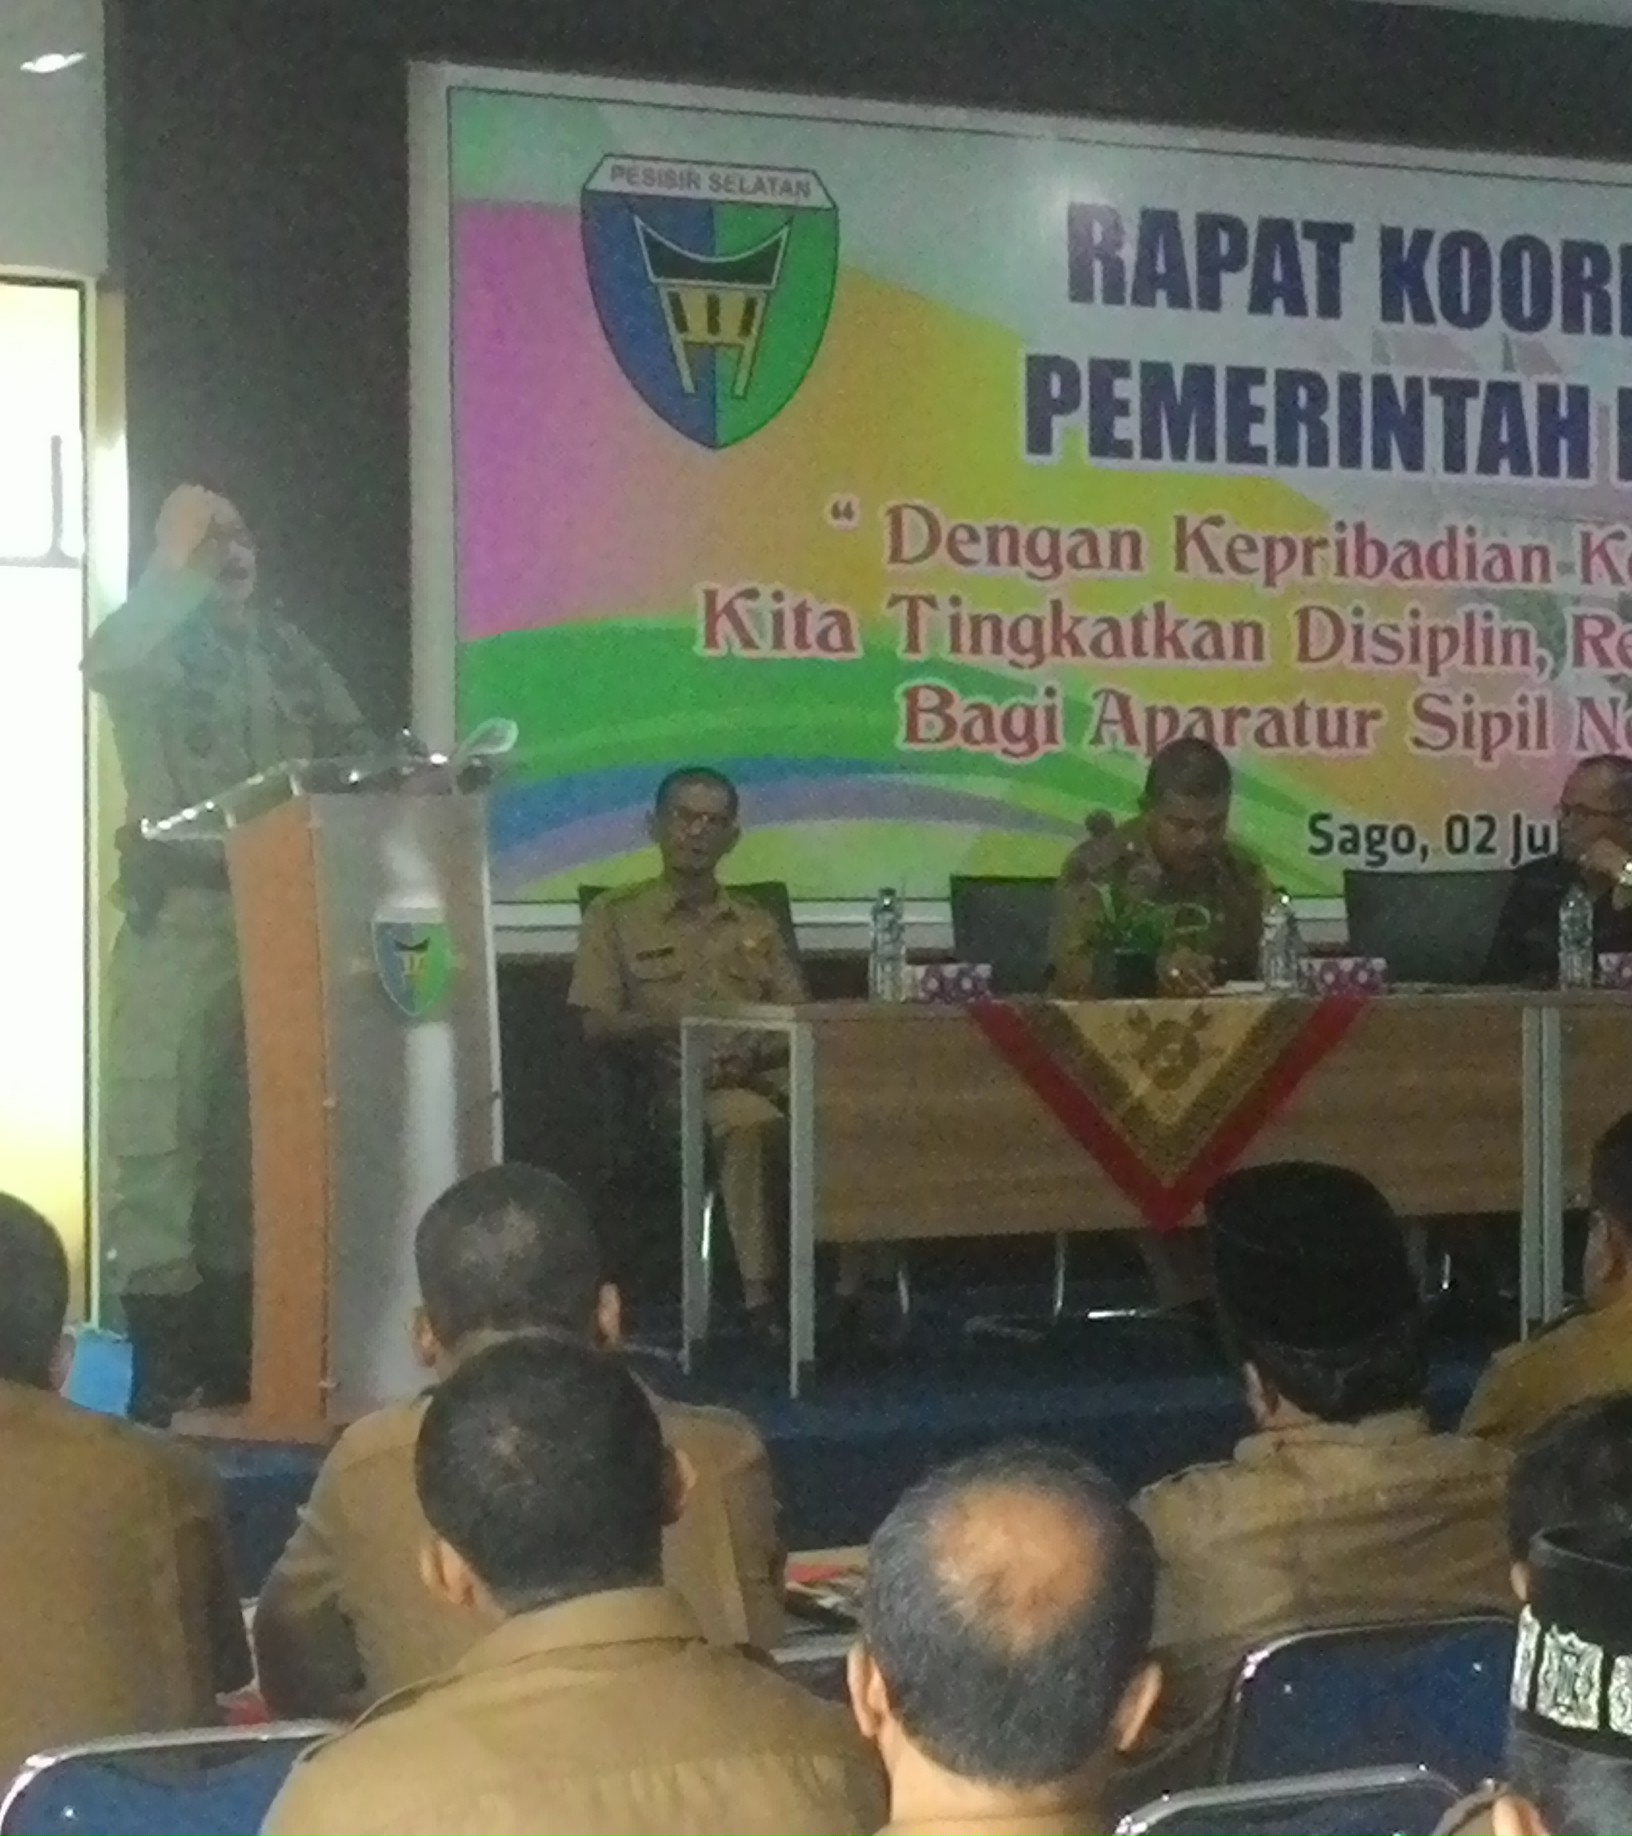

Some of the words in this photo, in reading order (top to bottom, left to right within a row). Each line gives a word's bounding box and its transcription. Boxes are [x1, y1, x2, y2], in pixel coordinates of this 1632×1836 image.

[610, 165, 700, 190] PESISIR
[708, 171, 812, 198] SELATAN
[1067, 202, 1354, 319] RAPAT
[1025, 354, 1590, 479] PEMERINTAH
[885, 503, 1144, 580] Dengan
[1173, 514, 1552, 588] Kepribadian
[702, 587, 856, 653] Kita
[886, 593, 1265, 669] Tingkatkan
[1294, 605, 1552, 679] Disiplin,
[903, 684, 1060, 758] Bagi
[1088, 688, 1384, 758] Aparatur
[1410, 693, 1550, 762] Sipil
[1307, 811, 1430, 867] Sago,
[1445, 814, 1497, 856] 02
[1510, 813, 1562, 866] Ju
